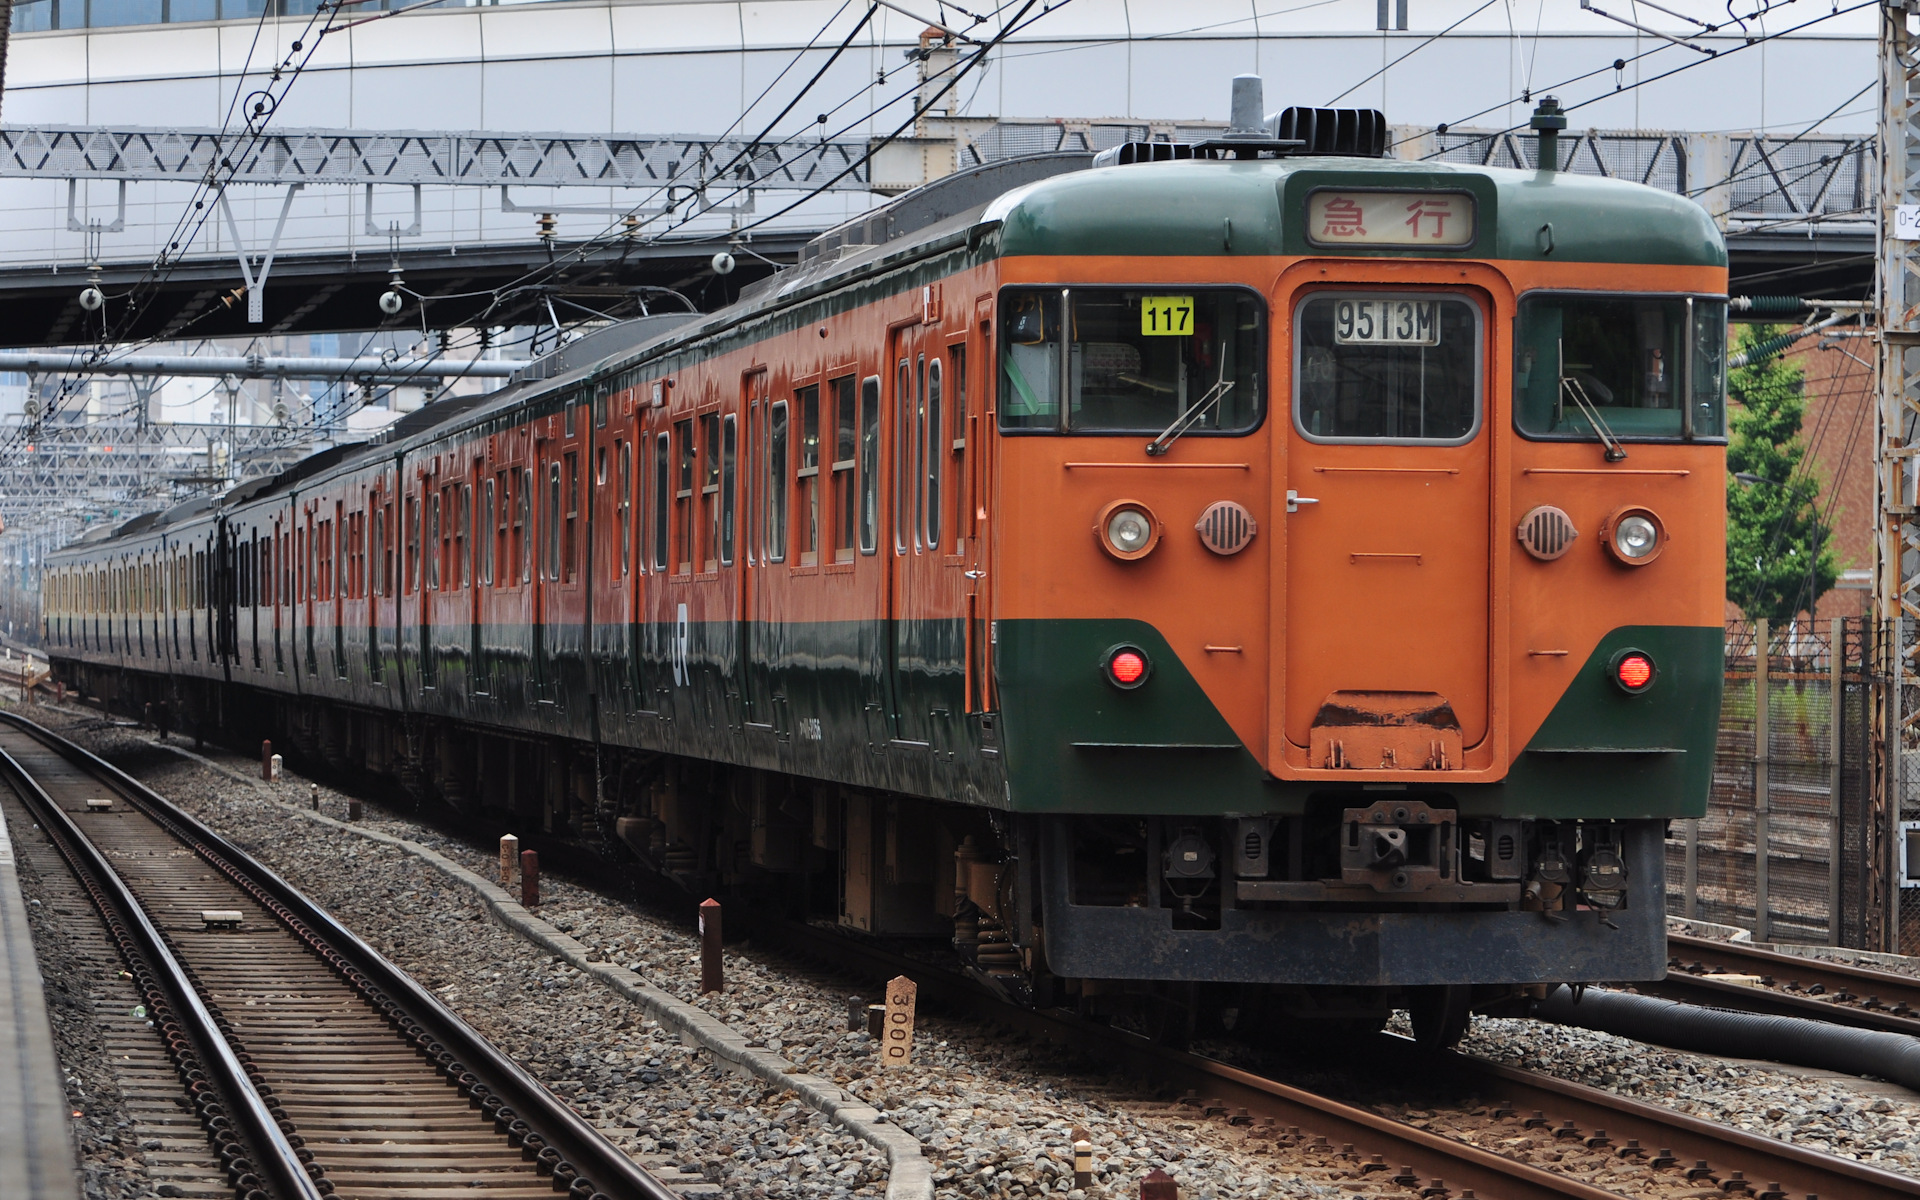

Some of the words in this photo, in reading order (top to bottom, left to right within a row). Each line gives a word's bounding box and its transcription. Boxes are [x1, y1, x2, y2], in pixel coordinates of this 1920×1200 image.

[1322, 196, 1452, 239] 急行
[1146, 306, 1190, 331] 117
[1337, 301, 1434, 340] 9513M
[671, 603, 691, 687] JR
[889, 994, 909, 1058] 3000
